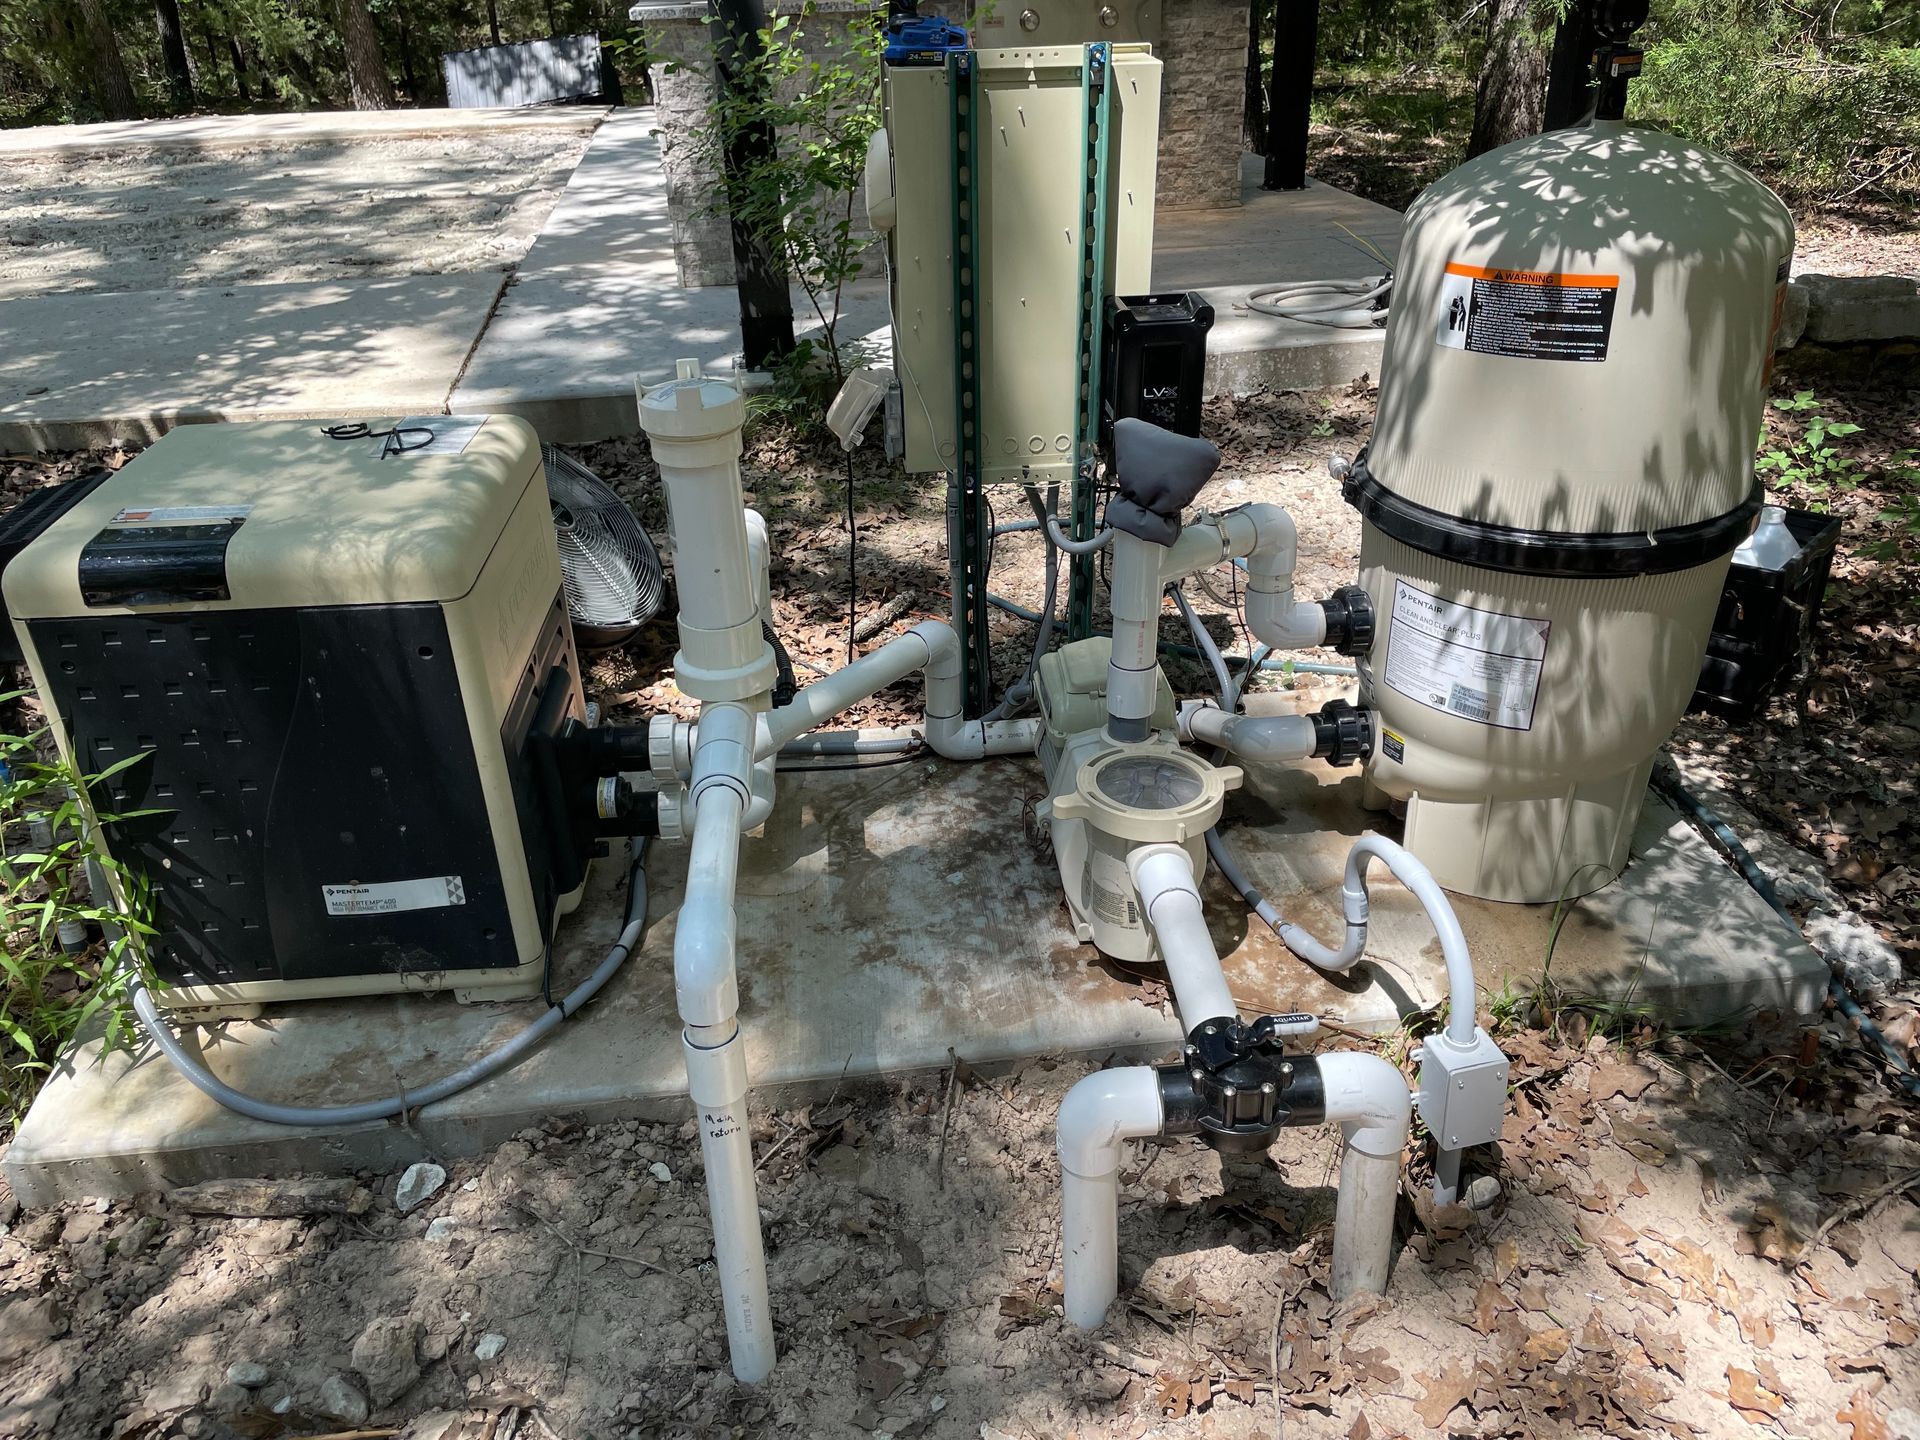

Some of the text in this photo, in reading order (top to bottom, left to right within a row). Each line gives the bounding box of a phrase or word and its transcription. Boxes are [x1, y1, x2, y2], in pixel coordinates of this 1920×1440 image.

[1505, 272, 1554, 284] WARNING
[1144, 386, 1178, 398] LV-X
[1408, 594, 1443, 614] PENTAIR
[1400, 606, 1419, 620] CLEAN
[1419, 616, 1434, 626] AND
[1460, 630, 1481, 640] PLUS
[704, 1114, 735, 1124] Main
[710, 1126, 741, 1138] return
